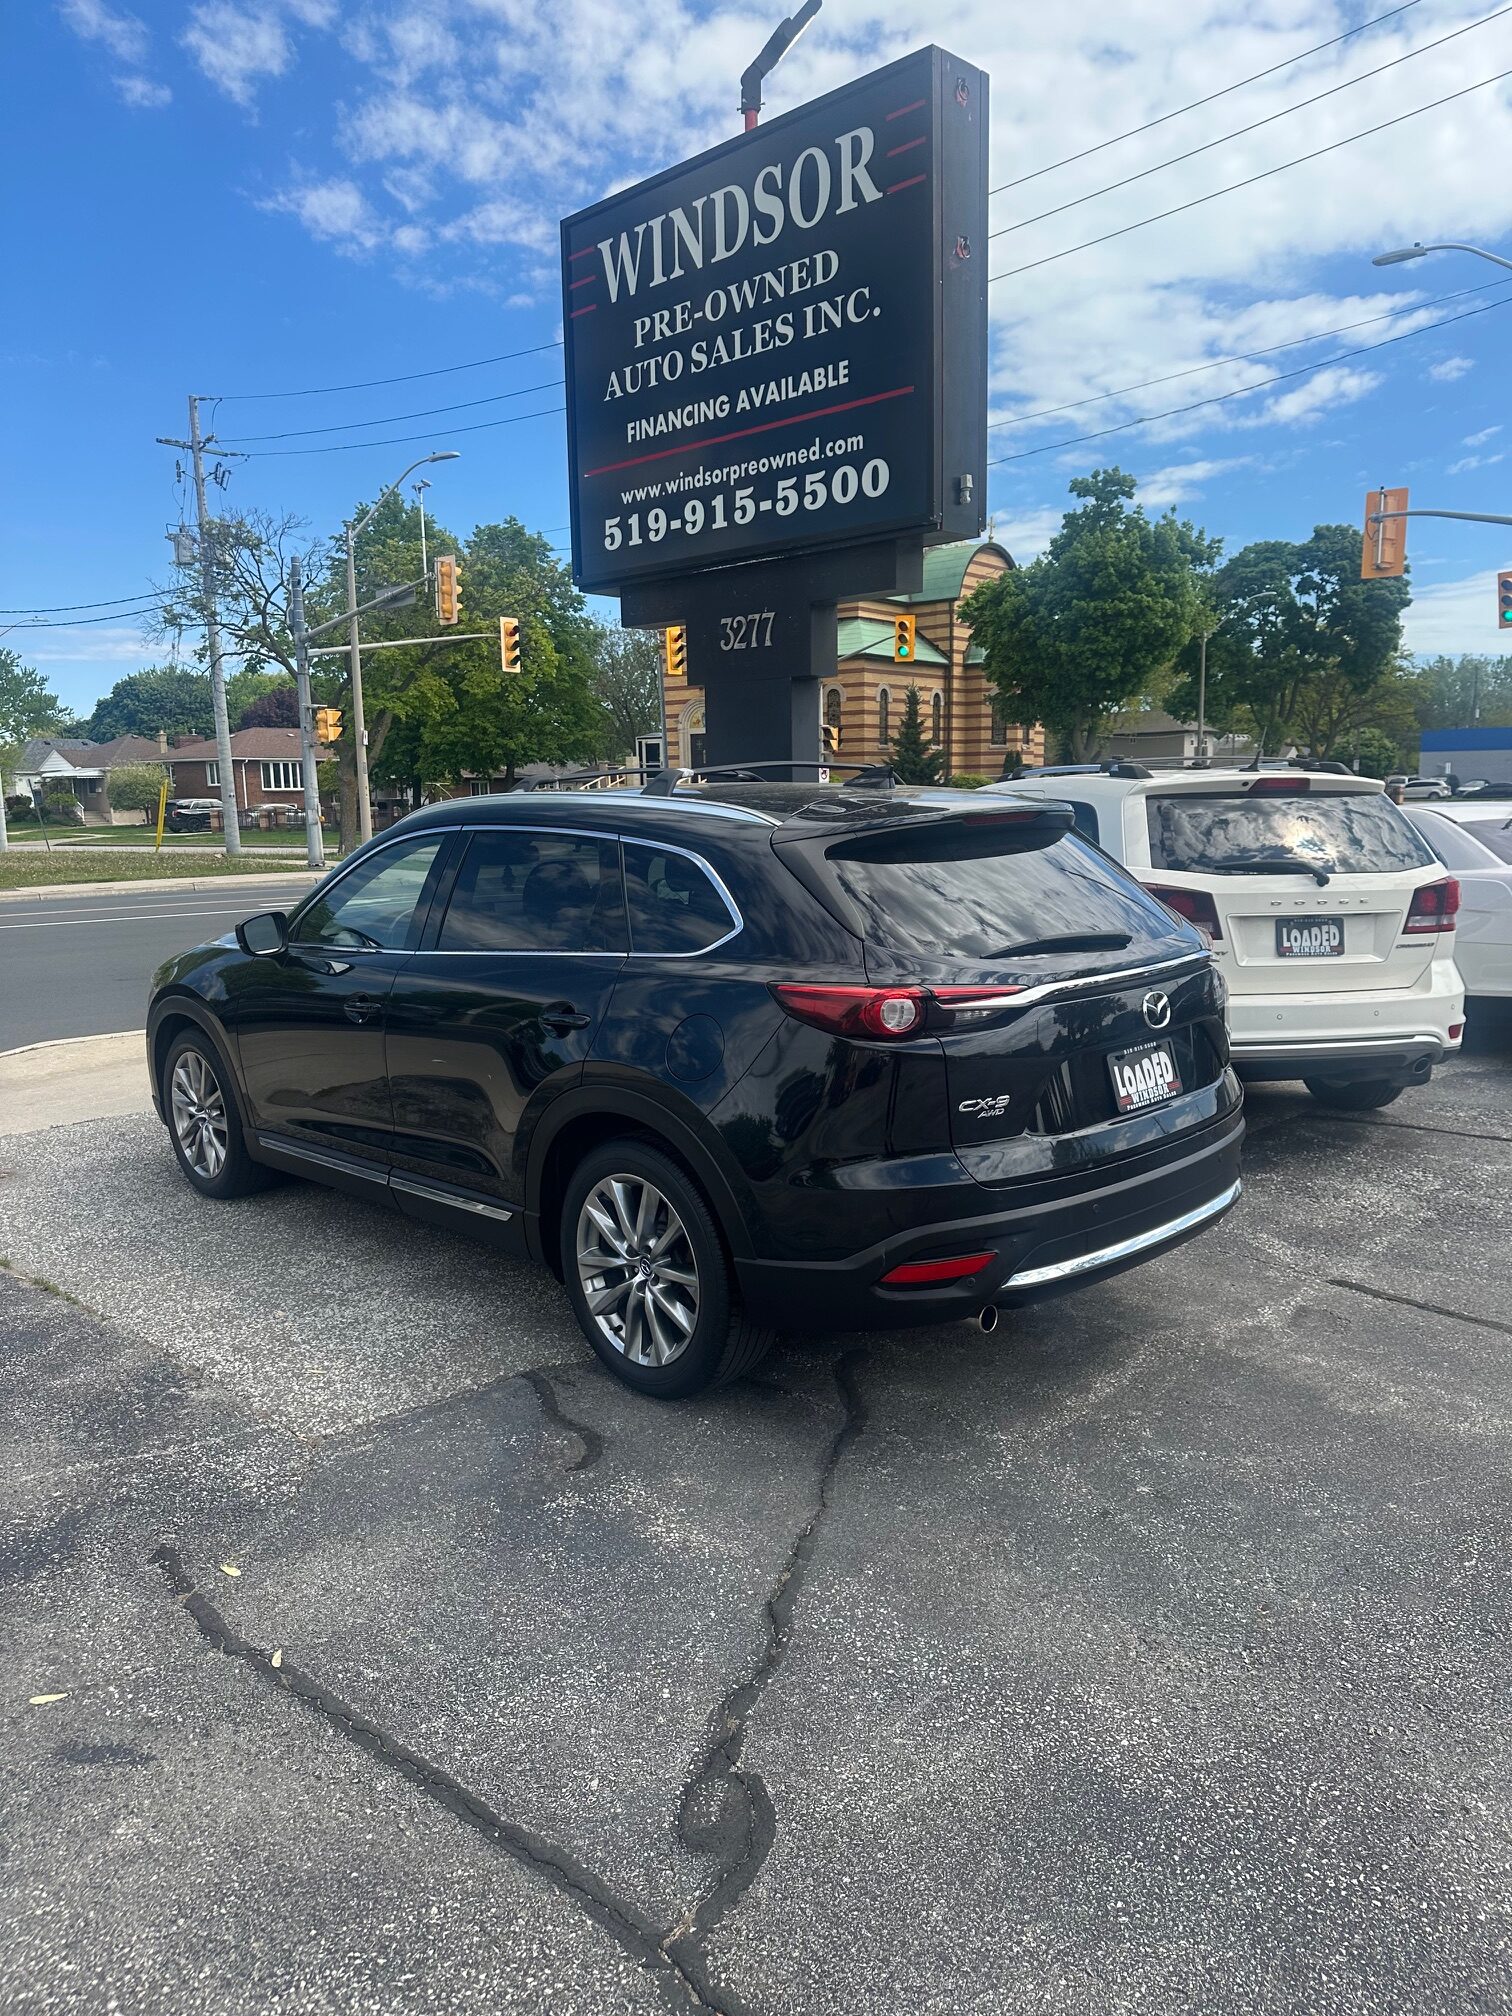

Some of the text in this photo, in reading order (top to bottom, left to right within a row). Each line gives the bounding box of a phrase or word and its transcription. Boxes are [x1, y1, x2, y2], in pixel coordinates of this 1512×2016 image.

[597, 126, 883, 304] WINDSOR
[633, 250, 840, 349] PRE-OWNED
[604, 286, 881, 402] AUTO SALES INC.
[627, 360, 849, 443] FINANCING AVAILABLE
[621, 434, 865, 505] www.windsorpreowned.com
[604, 458, 890, 551] 519-915-5500
[720, 611, 776, 651] 3277
[1270, 898, 1369, 906] DODGE
[1282, 924, 1340, 947] LOADED
[1292, 945, 1332, 953] WINDSOR
[1113, 1051, 1174, 1097] LOADED
[1130, 1083, 1170, 1103] WINDSOR
[958, 1094, 1011, 1112] CX-9
[977, 1107, 1005, 1119] AWD
